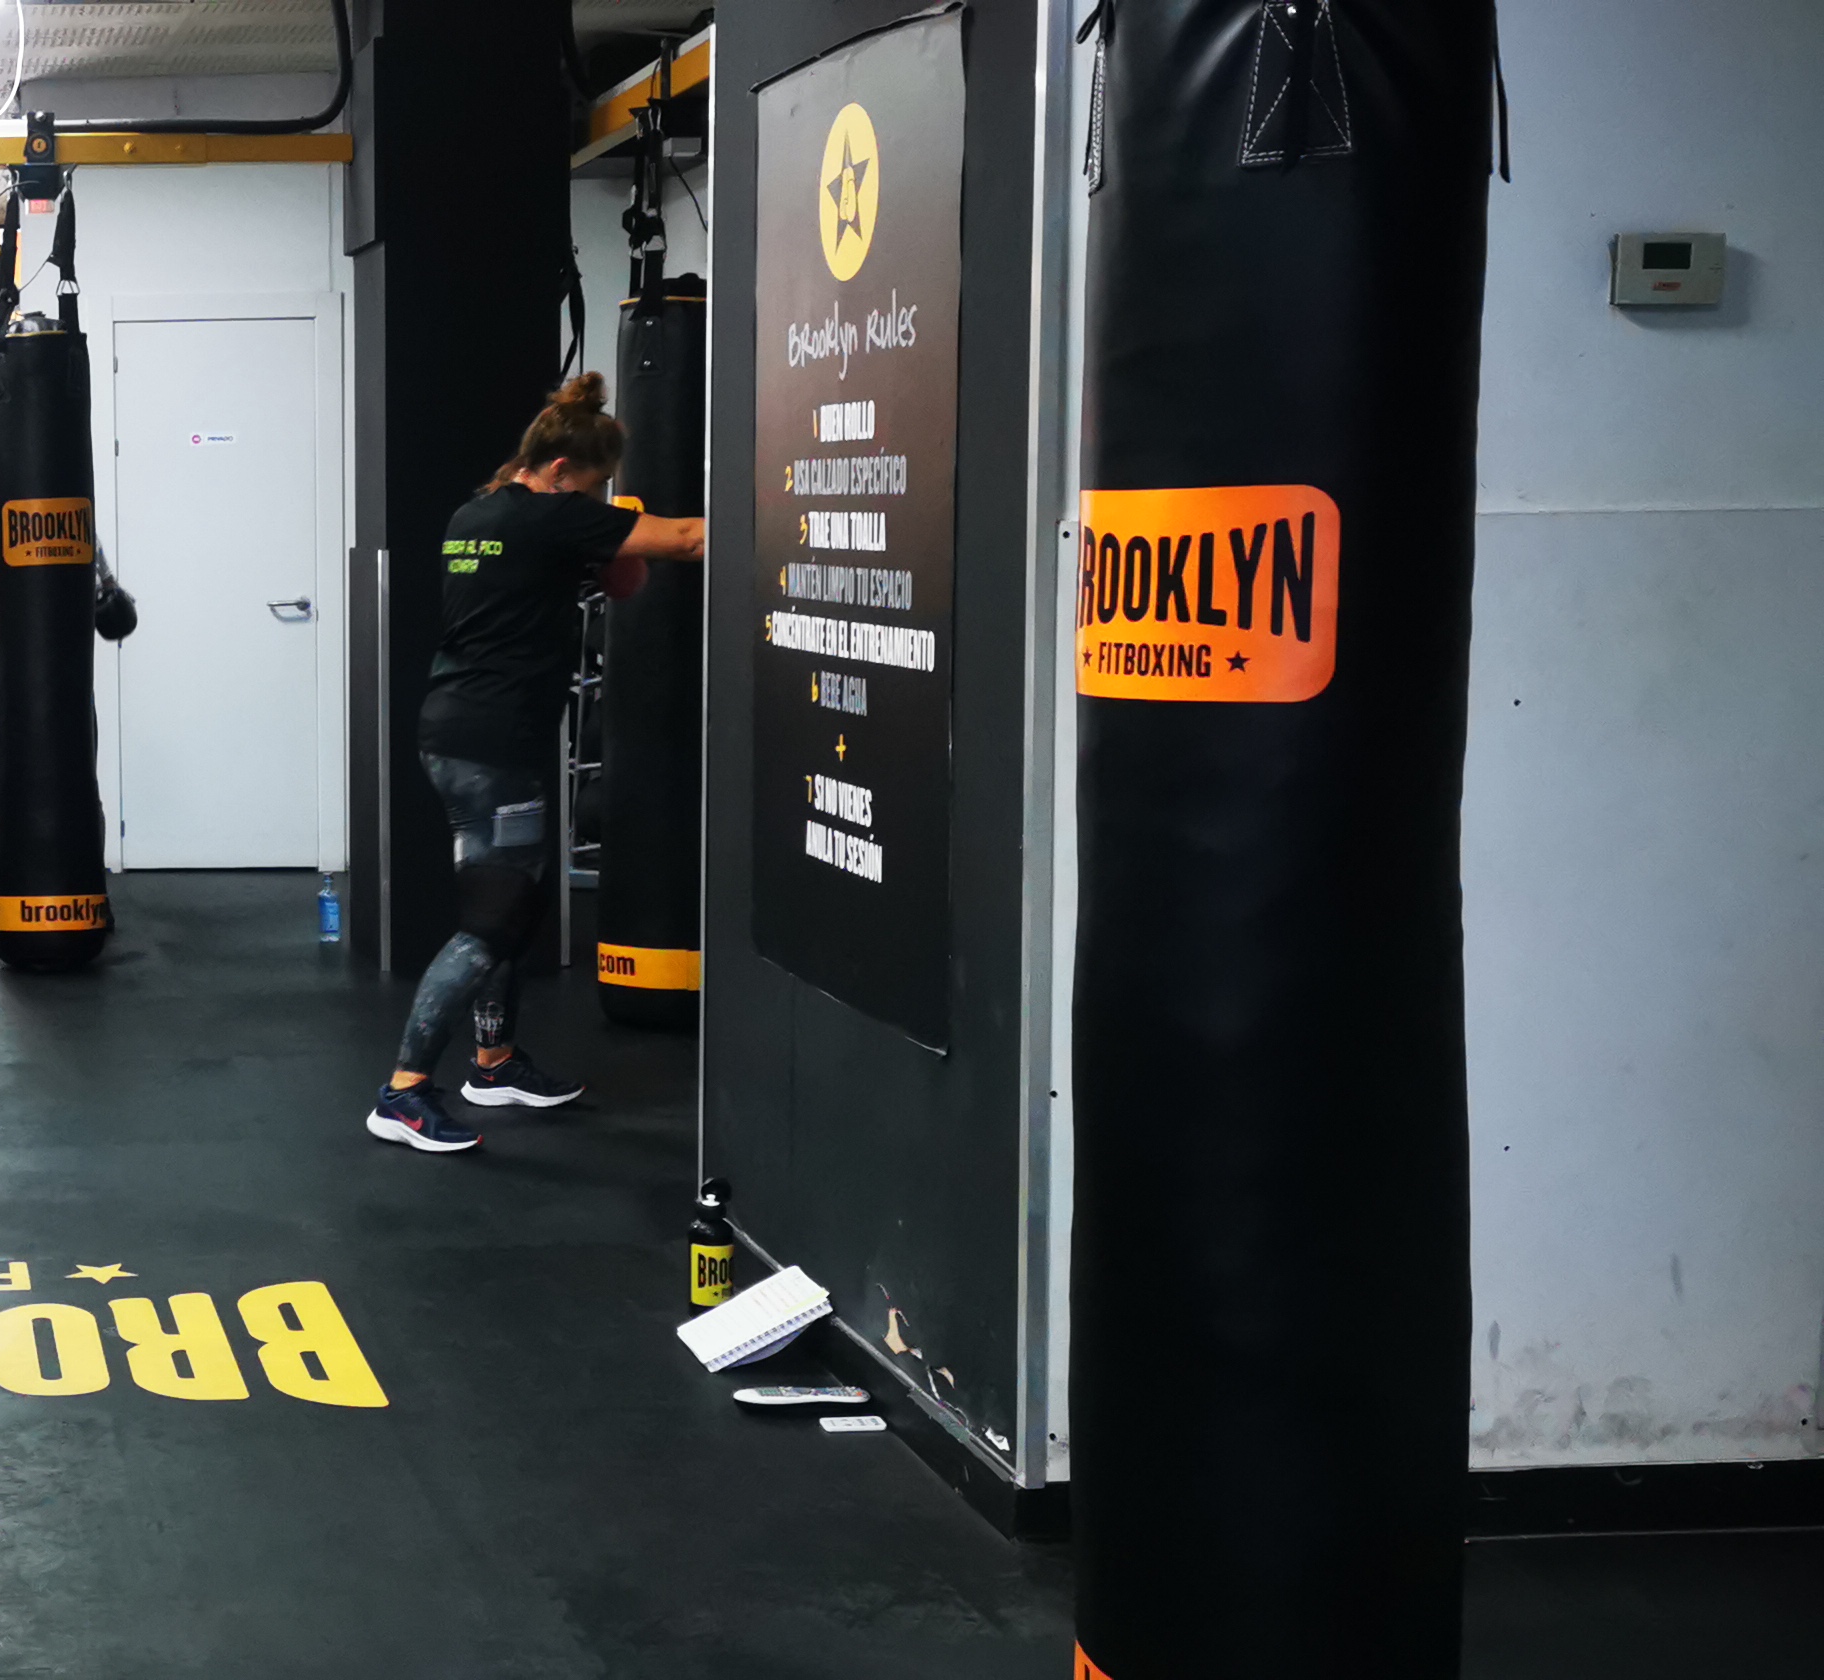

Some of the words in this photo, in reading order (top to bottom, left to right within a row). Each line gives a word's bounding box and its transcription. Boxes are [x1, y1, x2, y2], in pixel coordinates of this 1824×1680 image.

[866, 288, 918, 353] Rules
[820, 403, 844, 442] BUEN
[844, 400, 875, 441] ROLLO
[784, 466, 793, 492] 2
[794, 459, 810, 495] USA
[811, 457, 849, 495] CALZADO
[850, 446, 907, 495] ESPECÍFICO
[8, 505, 92, 549] BROOKLYN
[808, 511, 830, 548] TRAE
[830, 512, 849, 549] UNA
[850, 512, 886, 552] TOALLA
[823, 564, 855, 604] LIMPIO
[856, 568, 869, 606] TU
[870, 568, 912, 611] ESPACIO
[765, 614, 772, 641] 5
[826, 618, 838, 656] EN
[838, 620, 849, 658] EL
[850, 621, 935, 673] ENTRENAMIENTO
[1098, 642, 1211, 678] FITBOXING
[820, 670, 842, 711] BEBE
[842, 674, 867, 717] AGUA
[814, 773, 825, 811] SI
[825, 777, 838, 816] NO
[838, 781, 872, 827] VIENES
[805, 820, 833, 865] ANULA
[834, 829, 846, 869] TU
[846, 834, 883, 883] SESIÓN
